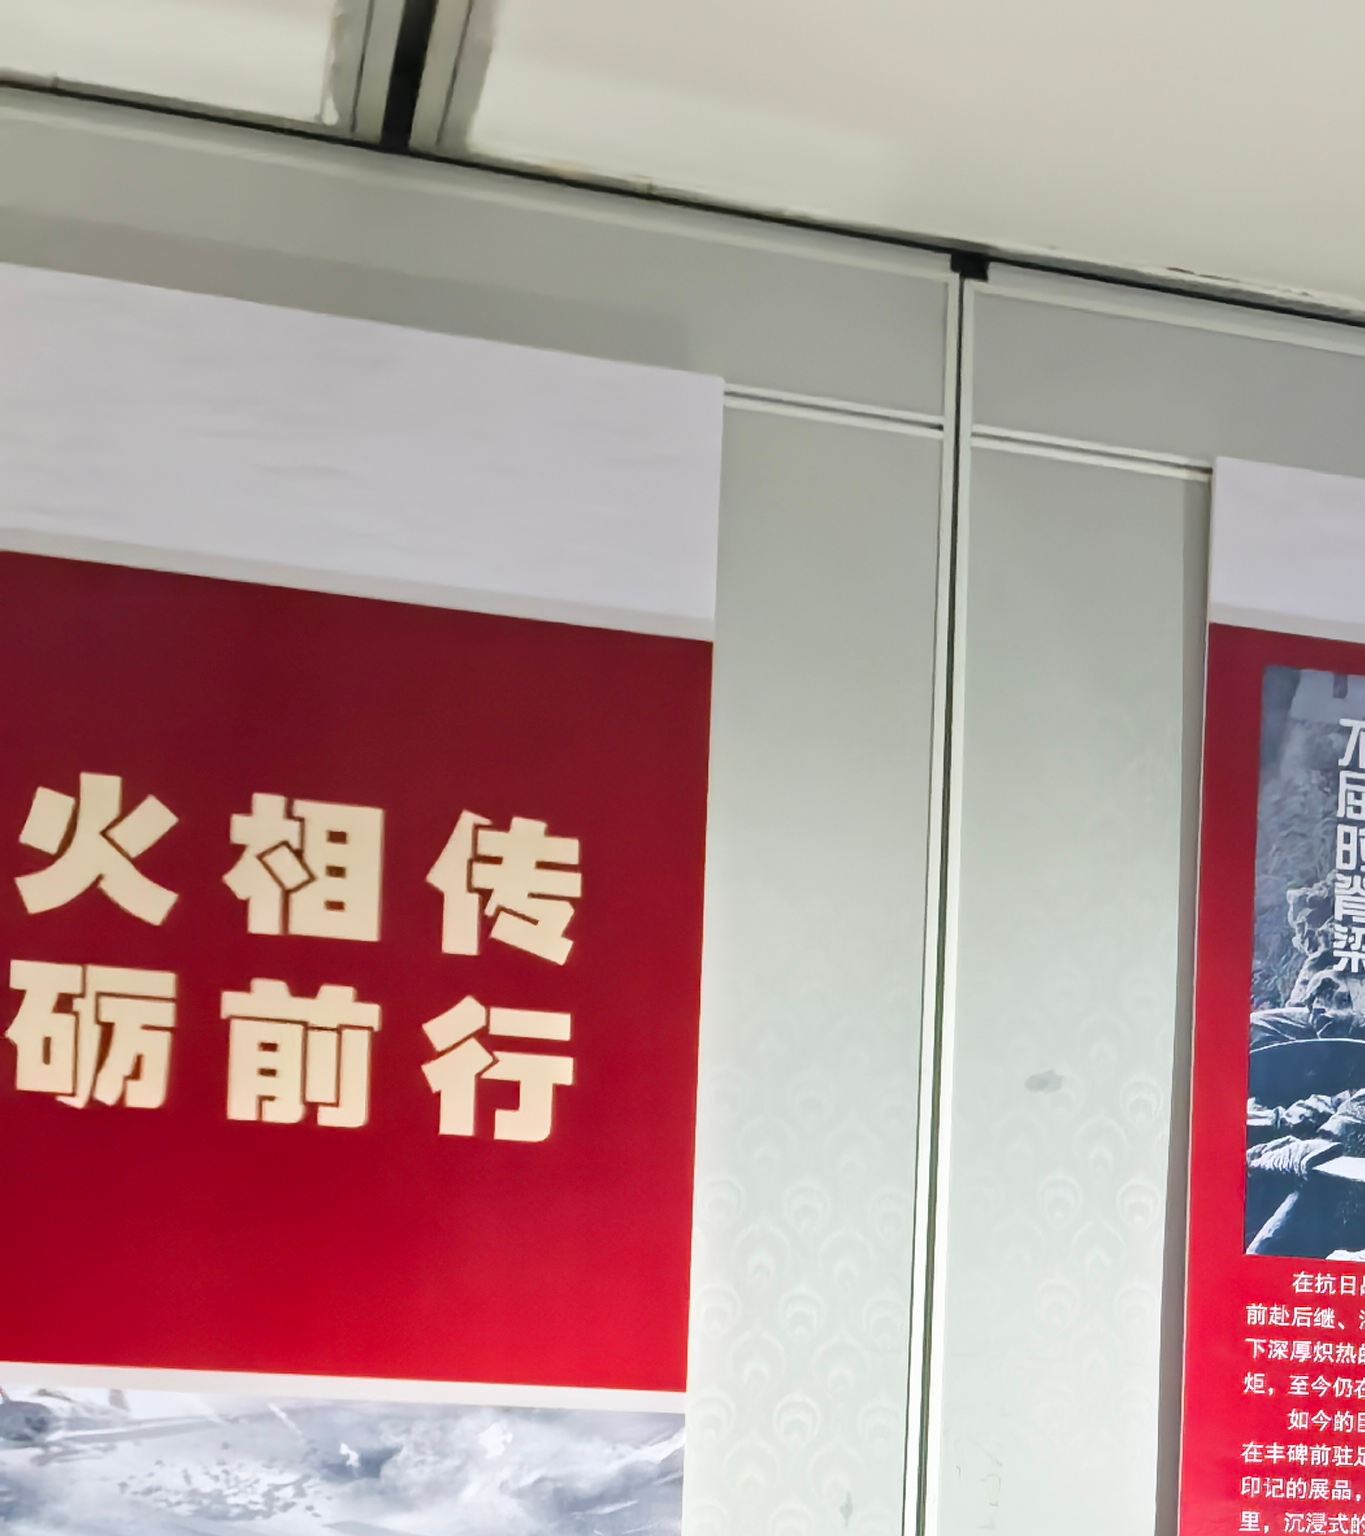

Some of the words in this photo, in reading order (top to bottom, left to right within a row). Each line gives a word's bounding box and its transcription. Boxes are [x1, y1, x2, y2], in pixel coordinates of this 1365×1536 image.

[14, 772, 583, 966] 火相传
[5, 959, 576, 1142] 砺前行
